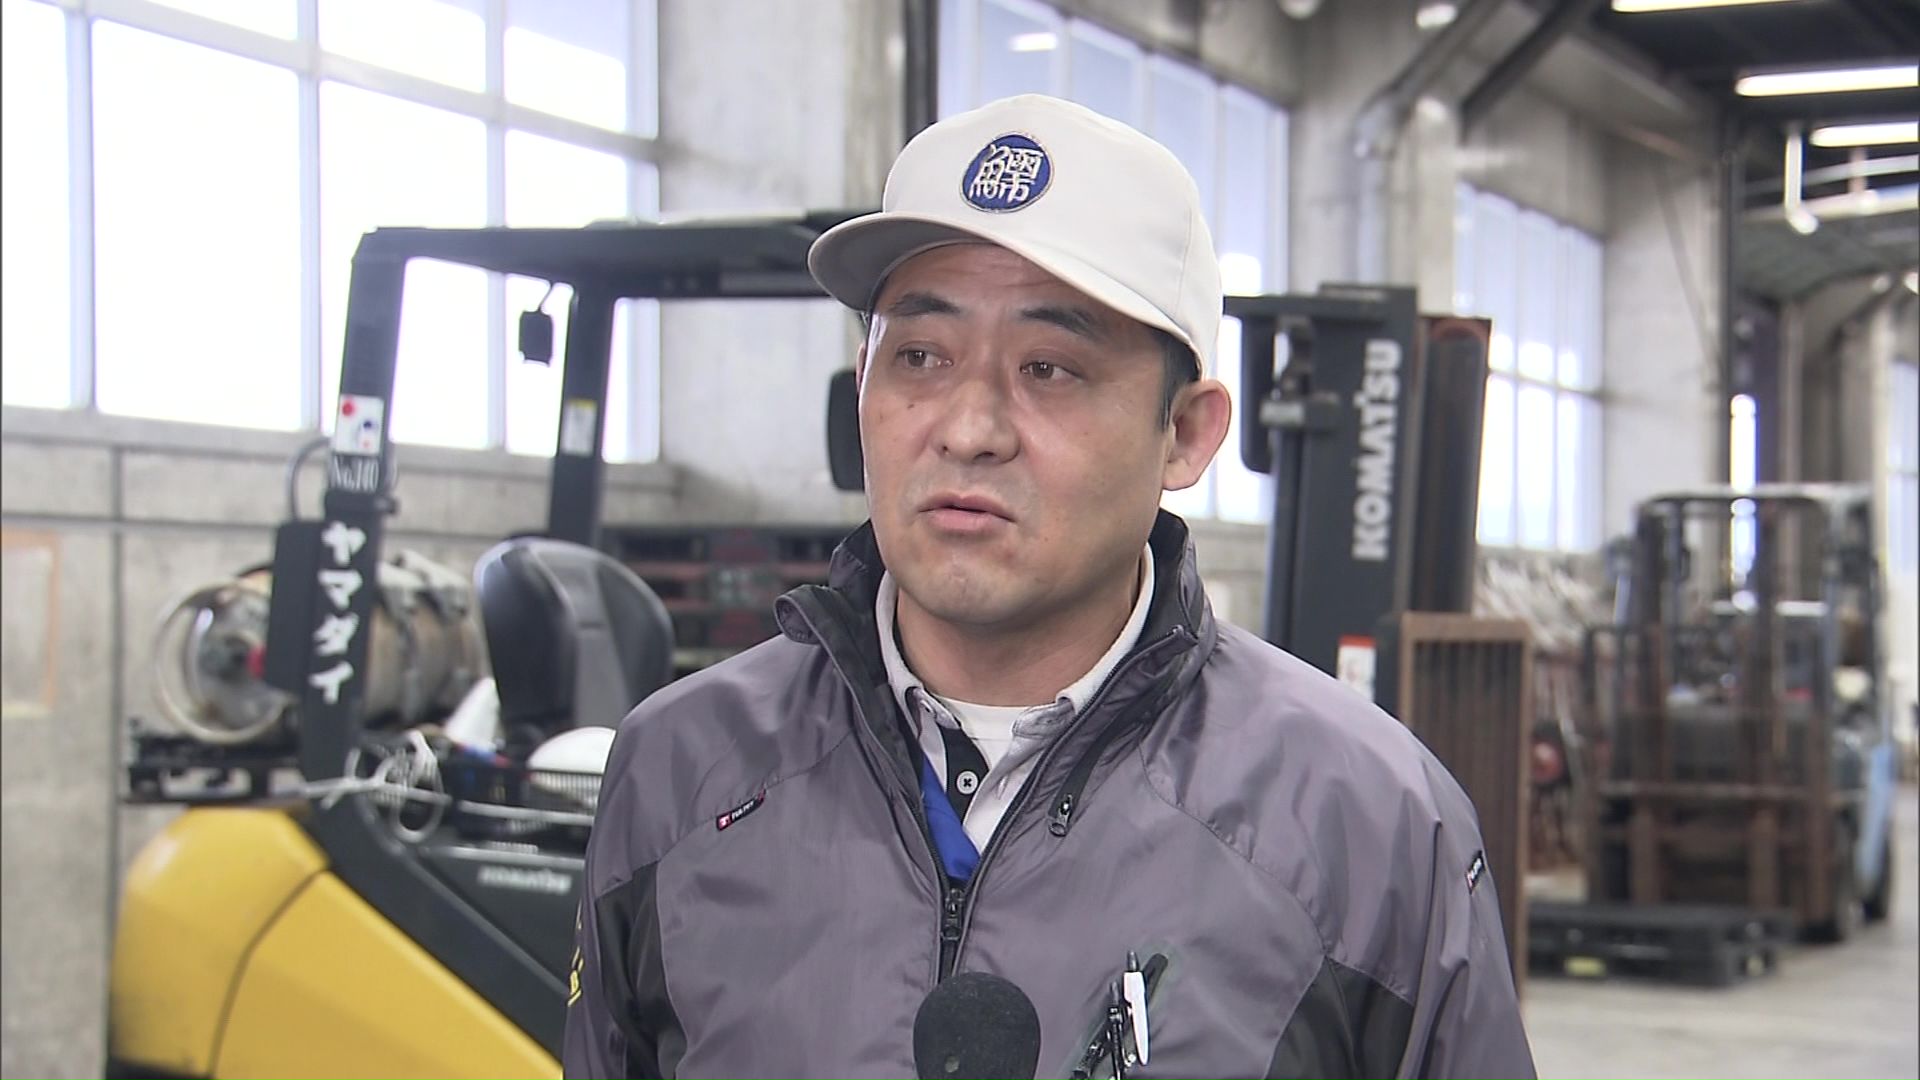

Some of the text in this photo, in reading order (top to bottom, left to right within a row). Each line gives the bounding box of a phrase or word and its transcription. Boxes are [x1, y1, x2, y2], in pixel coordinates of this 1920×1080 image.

[1352, 338, 1402, 562] KOMATSU
[309, 520, 366, 705] ヤマダイ
